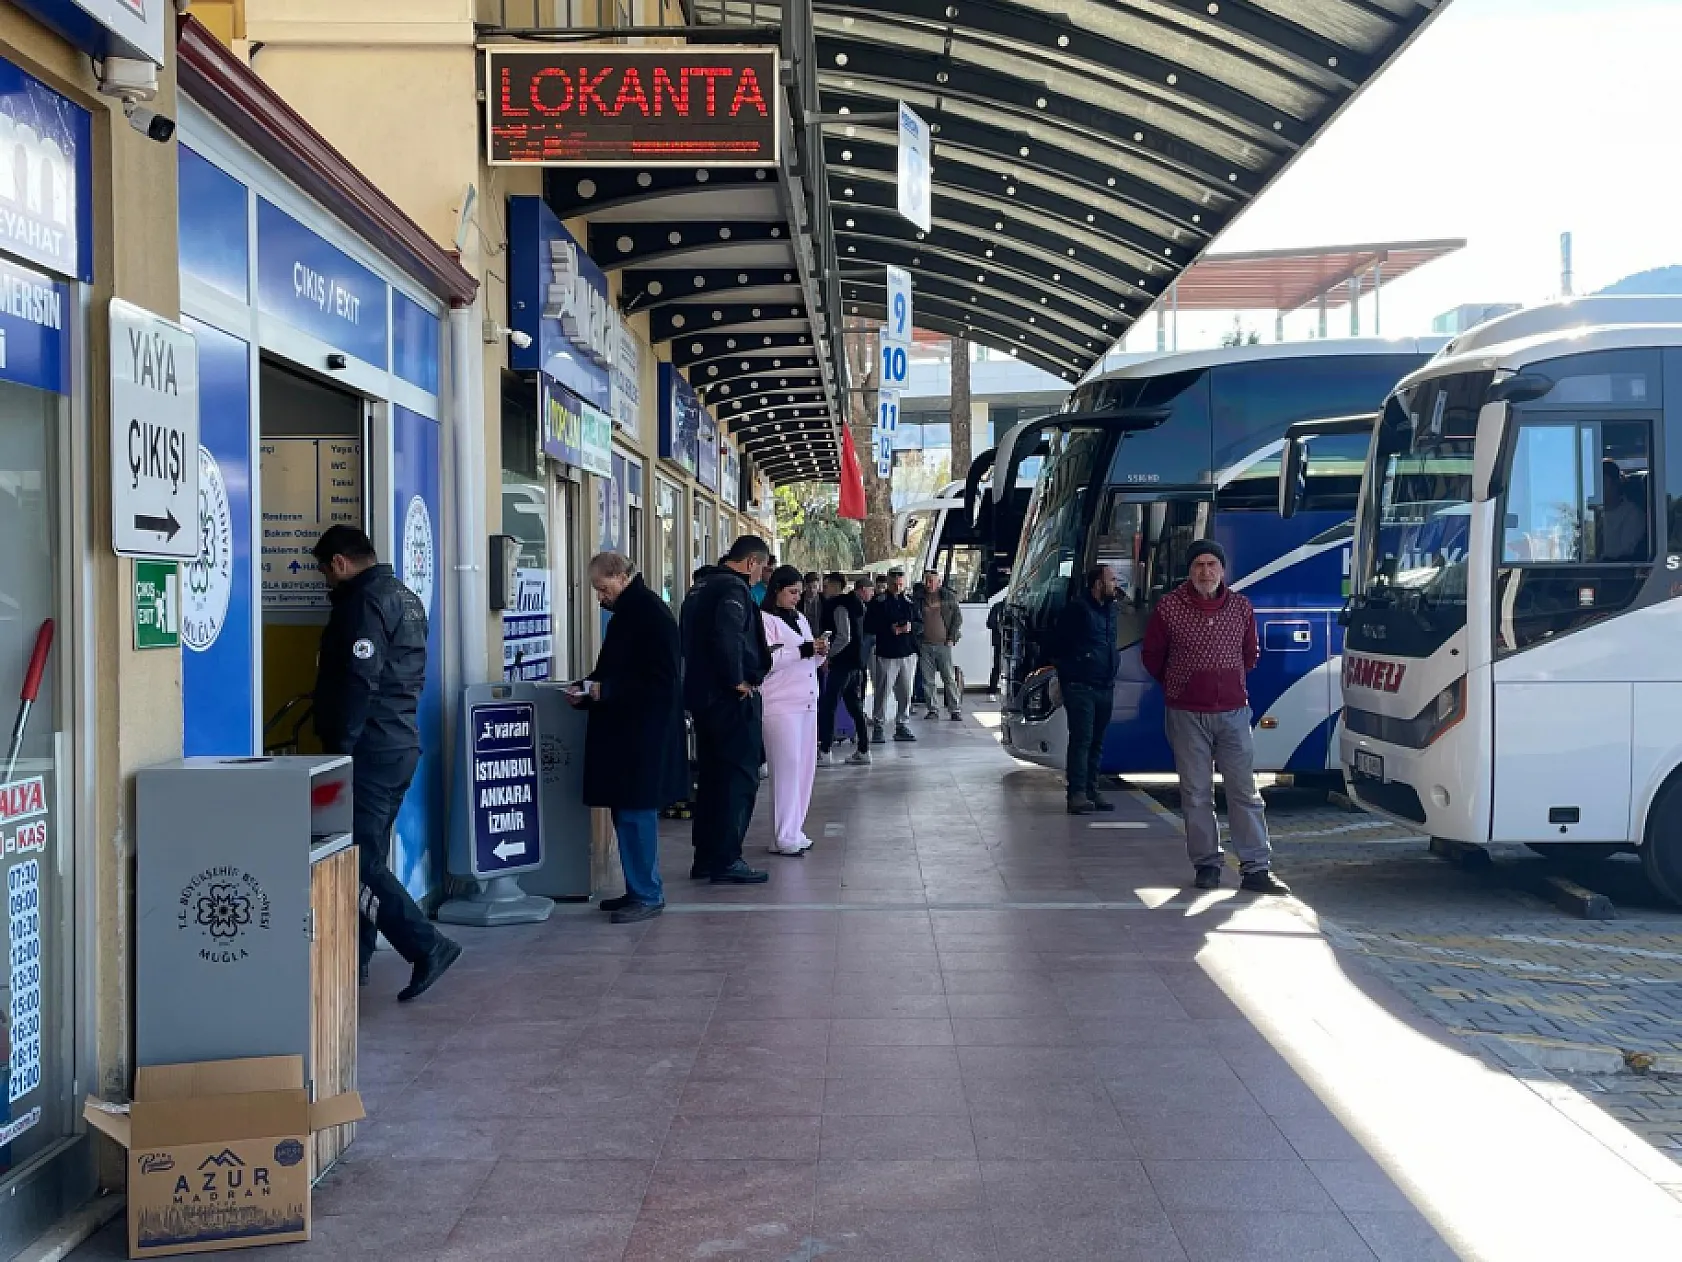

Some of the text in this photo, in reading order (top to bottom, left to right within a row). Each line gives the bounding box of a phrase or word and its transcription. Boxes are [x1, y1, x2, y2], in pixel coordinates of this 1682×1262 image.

[501, 67, 769, 117] LOKANTA
[293, 260, 325, 312] ÇIKIŞ
[336, 286, 360, 325] EXIT
[894, 292, 906, 333] 9
[128, 327, 178, 396] YAYA
[882, 346, 907, 382] 10
[881, 403, 896, 431] 11
[128, 419, 186, 495] ÇIKIŞI
[331, 462, 347, 470] WC
[494, 721, 529, 738] varan
[475, 757, 535, 782] İSTANBUL
[480, 784, 532, 809] ANKARA
[488, 807, 525, 834] İZMİR
[18, 823, 45, 851] KAŞ
[174, 1167, 270, 1194] AZUR
